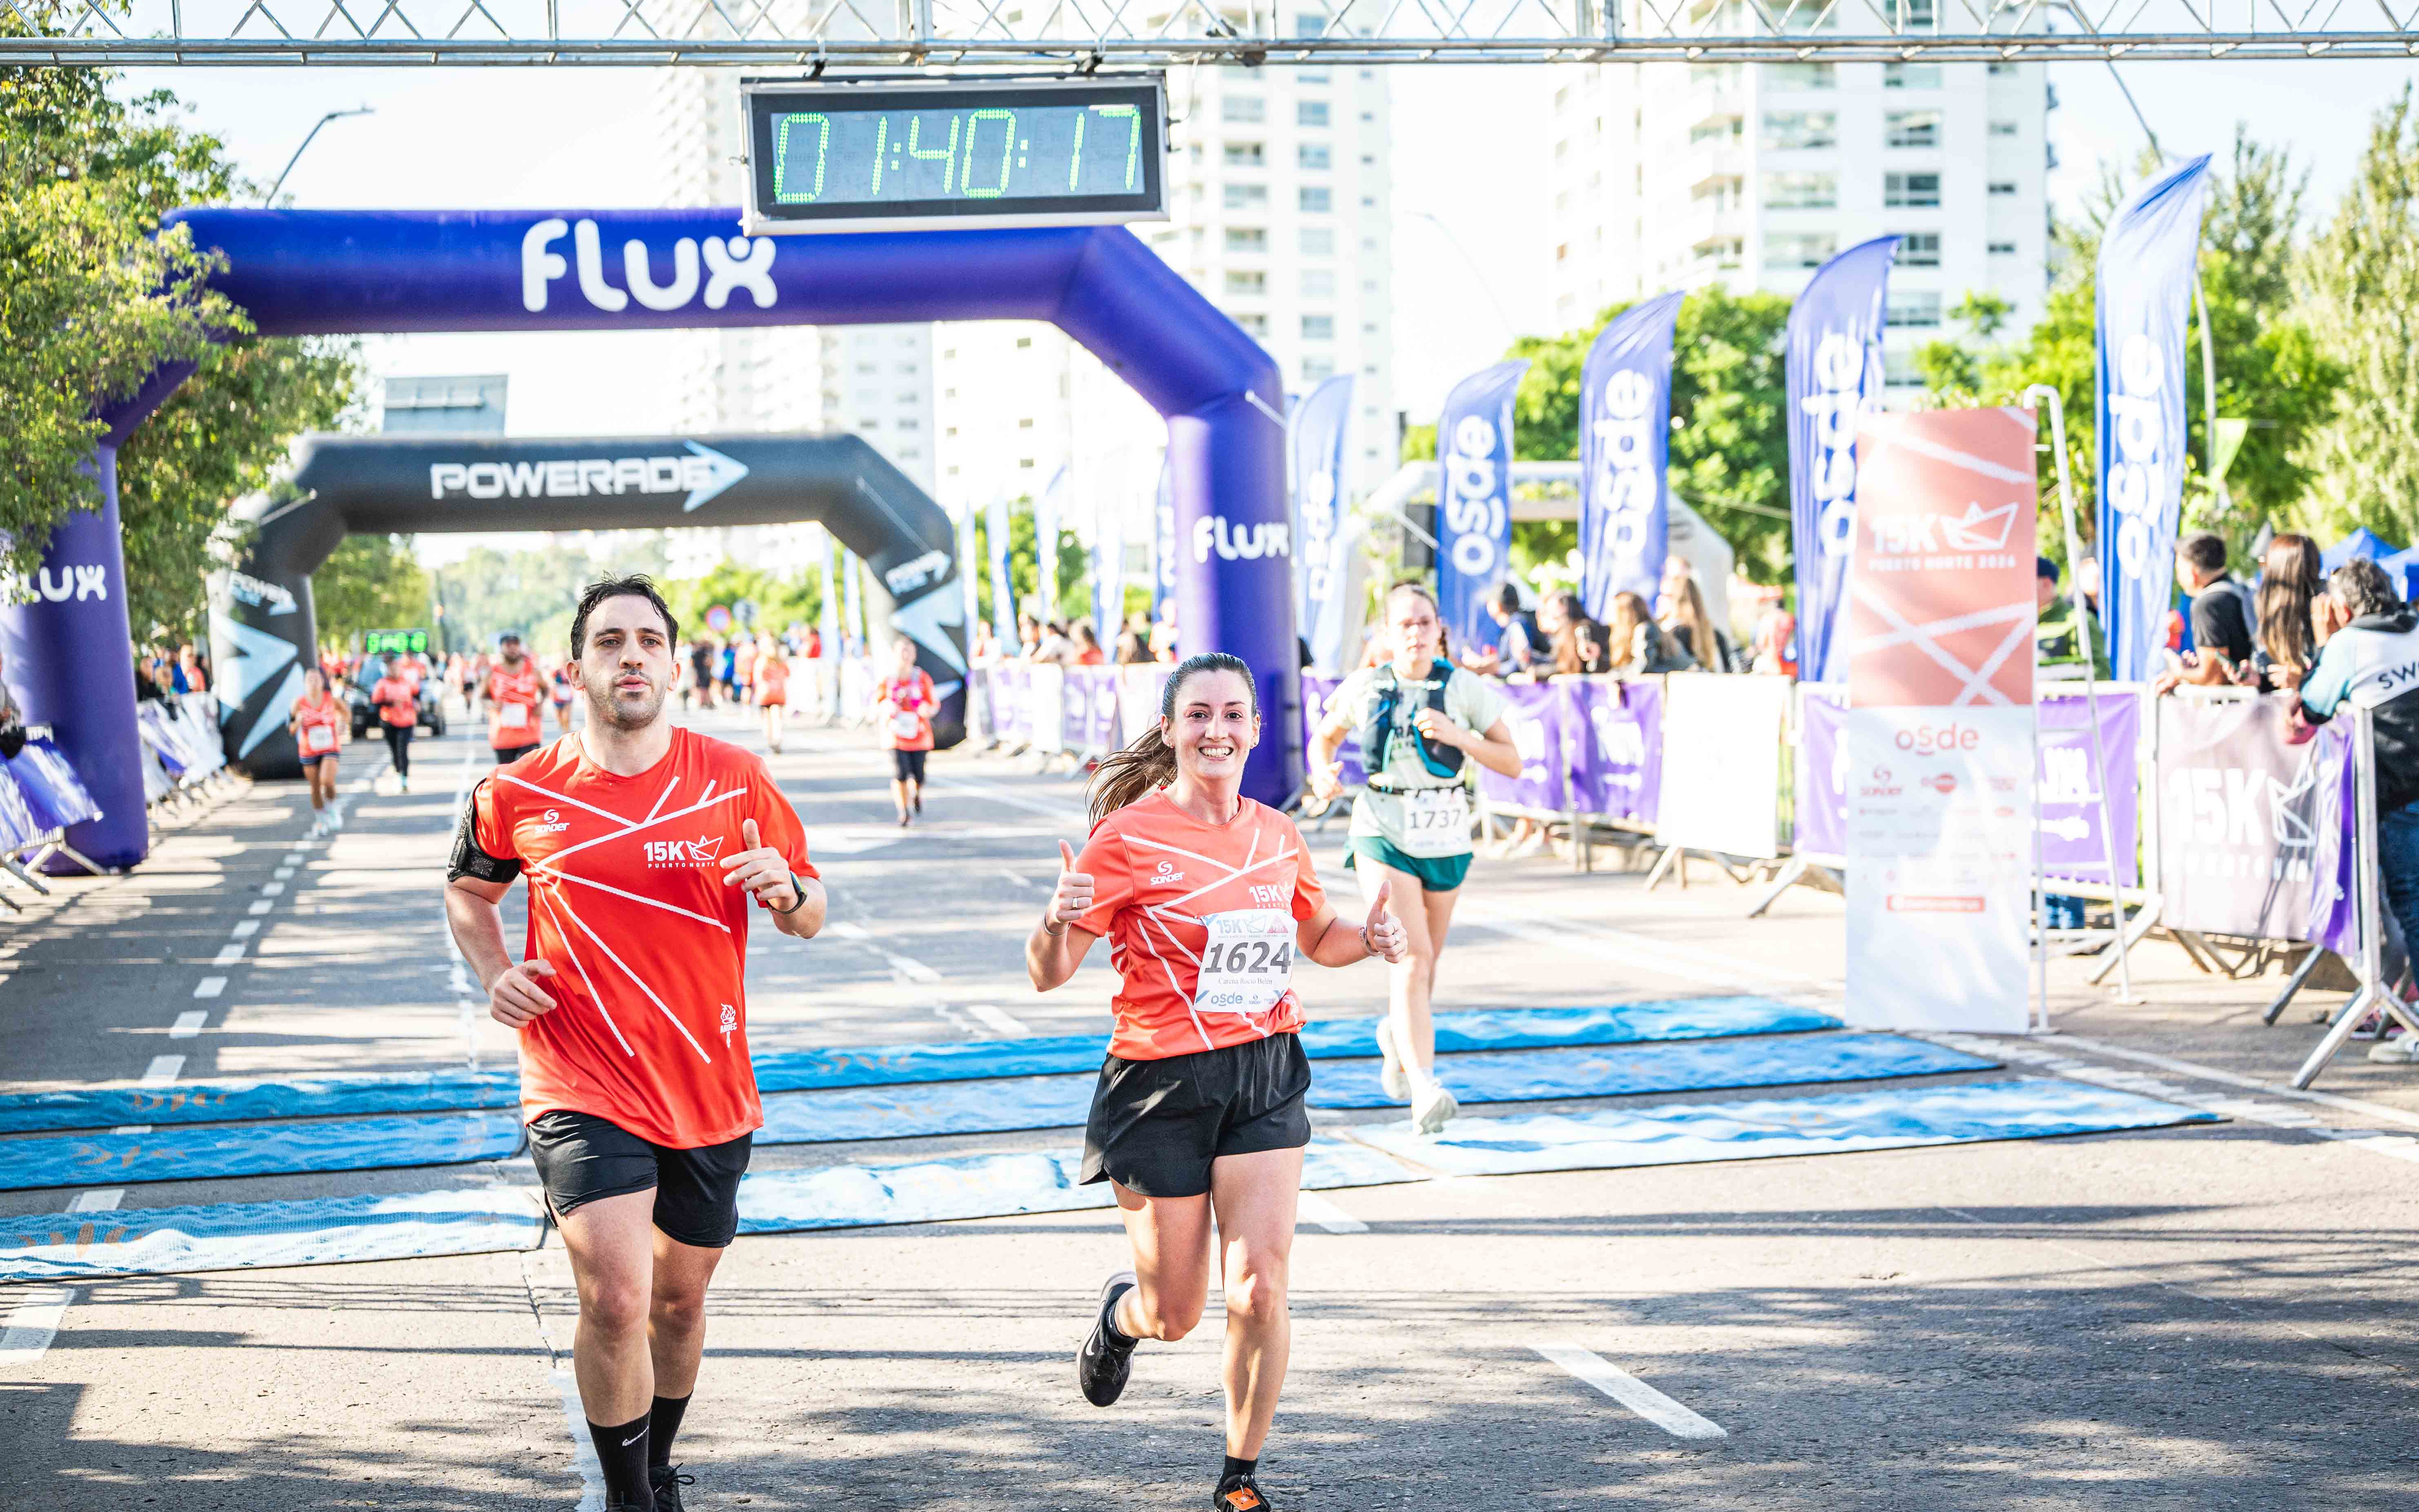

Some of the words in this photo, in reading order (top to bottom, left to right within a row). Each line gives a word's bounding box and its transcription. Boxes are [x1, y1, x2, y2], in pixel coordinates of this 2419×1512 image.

[774, 107, 1141, 203] 01:40:17
[430, 455, 713, 500] POWERADE
[1593, 368, 1657, 559] osde
[1445, 415, 1506, 576] osde
[1869, 513, 1939, 554] 15K
[1895, 722, 1979, 753] osde
[1410, 808, 1461, 828] 1737
[2168, 767, 2267, 846] 15K
[643, 840, 686, 862] 15K
[1248, 885, 1282, 903] 15K
[1217, 919, 1242, 933] 15K
[1204, 941, 1291, 974] 1624
[1211, 992, 1243, 1005] osde
